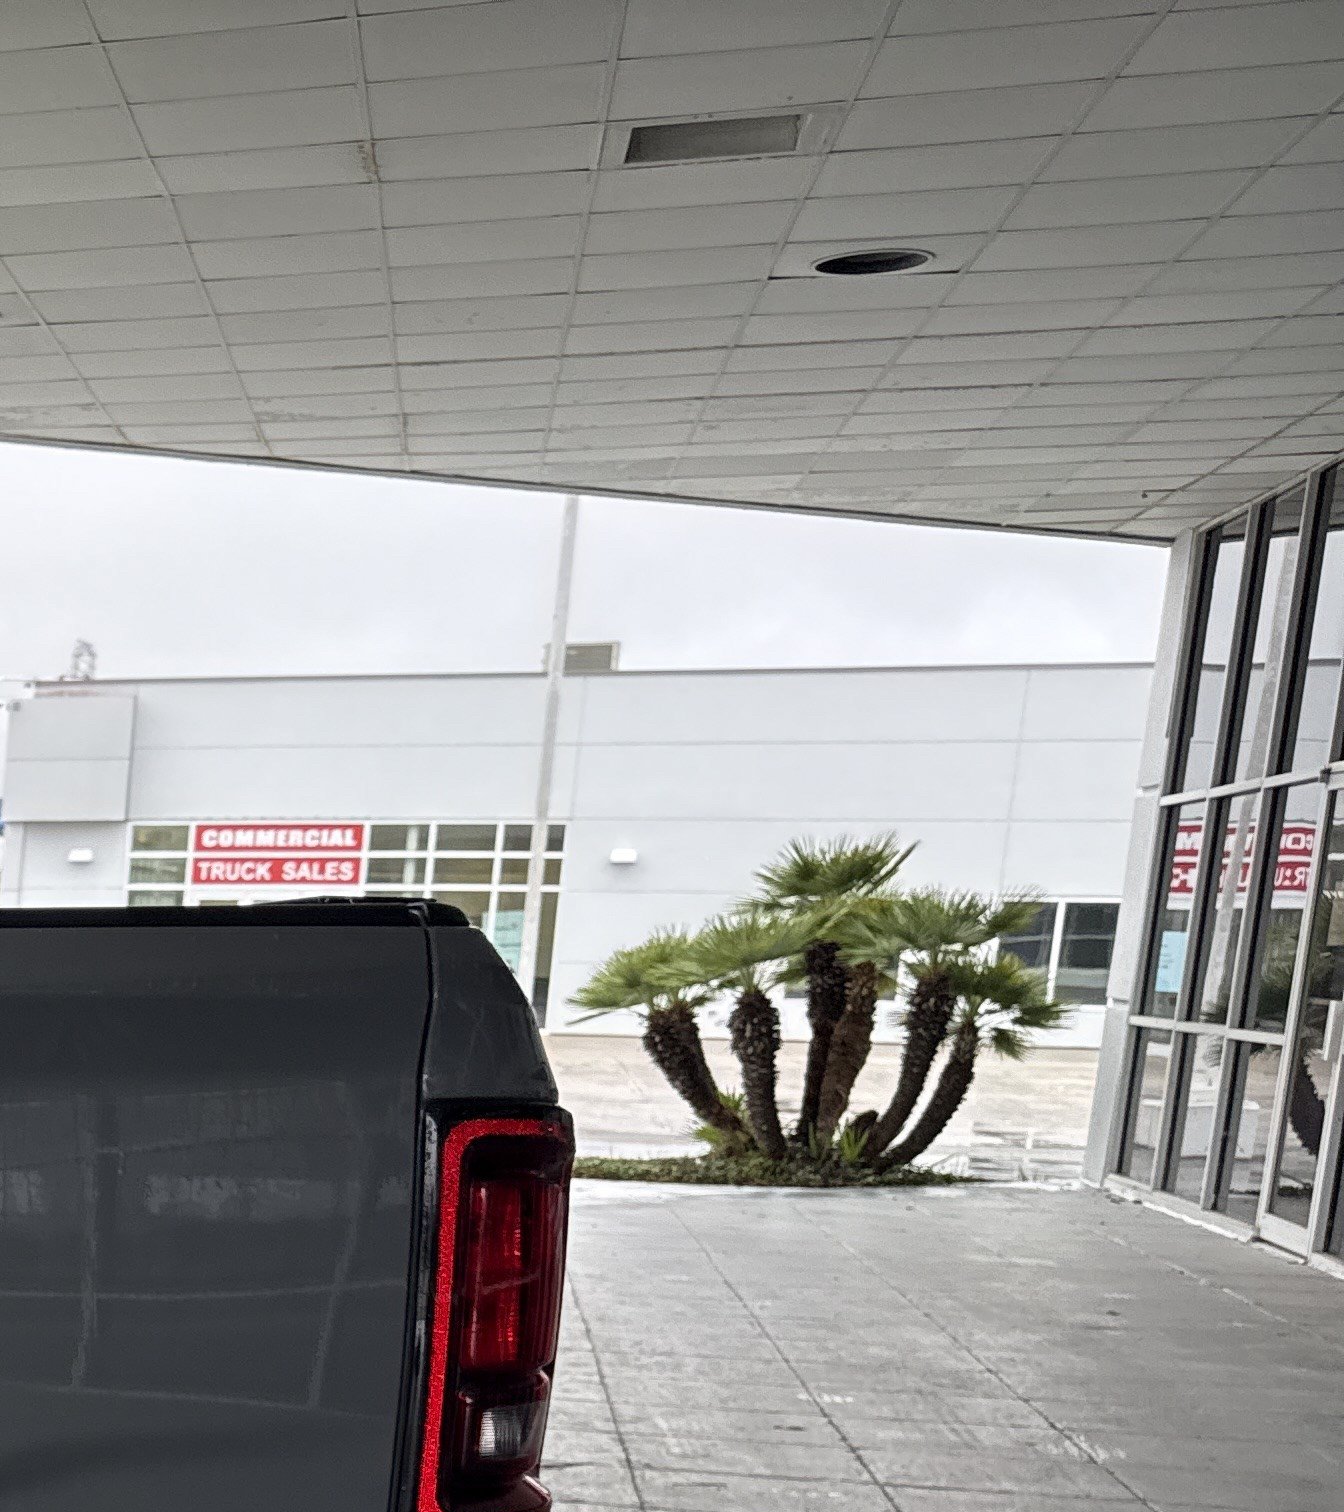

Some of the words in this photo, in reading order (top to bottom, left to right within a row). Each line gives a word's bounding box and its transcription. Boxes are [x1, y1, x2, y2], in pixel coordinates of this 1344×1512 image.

[201, 828, 357, 848] COMMERCIAL
[197, 861, 273, 881] TRUCK
[281, 860, 355, 881] SALES
